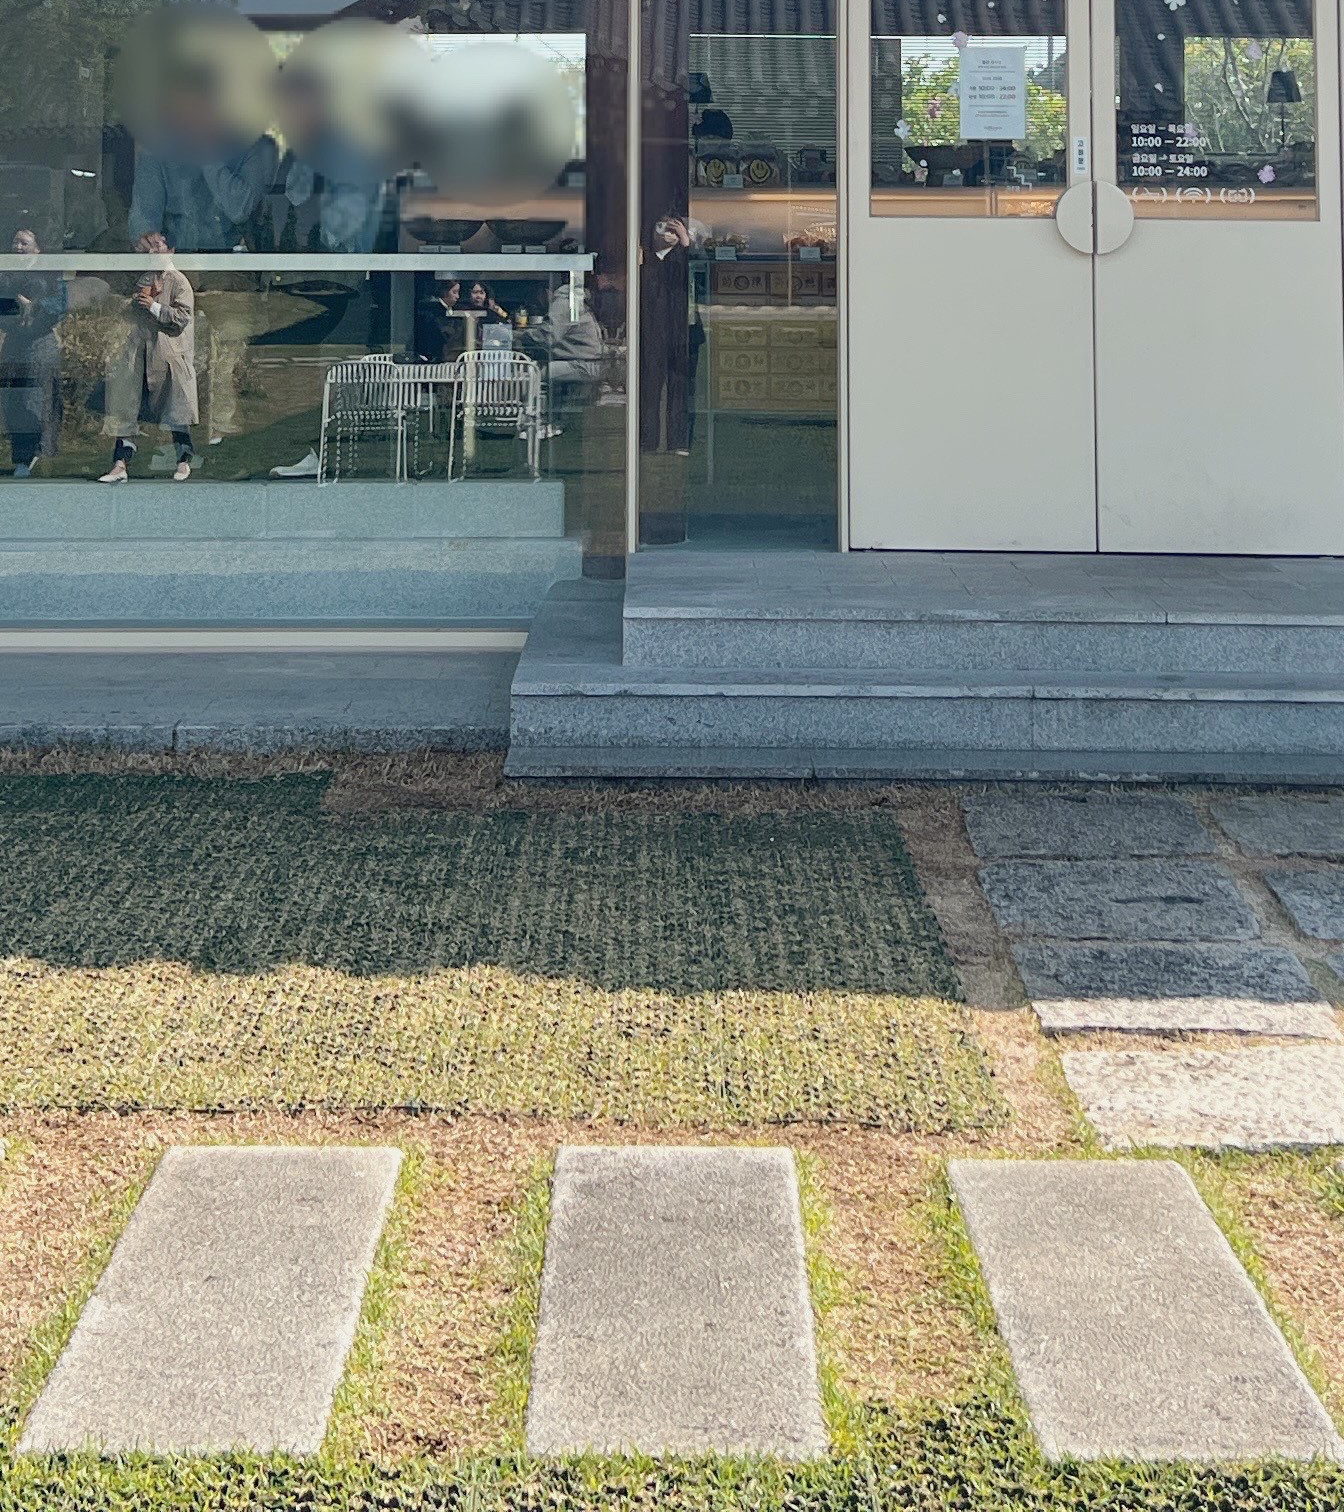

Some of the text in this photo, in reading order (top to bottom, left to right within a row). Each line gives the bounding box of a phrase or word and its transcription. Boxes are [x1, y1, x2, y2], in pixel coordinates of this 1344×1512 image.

[1131, 136, 1162, 148] 10:00
[1176, 136, 1207, 148] 22:00
[1132, 165, 1163, 177] 10:00
[1176, 165, 1208, 177] 24:00
